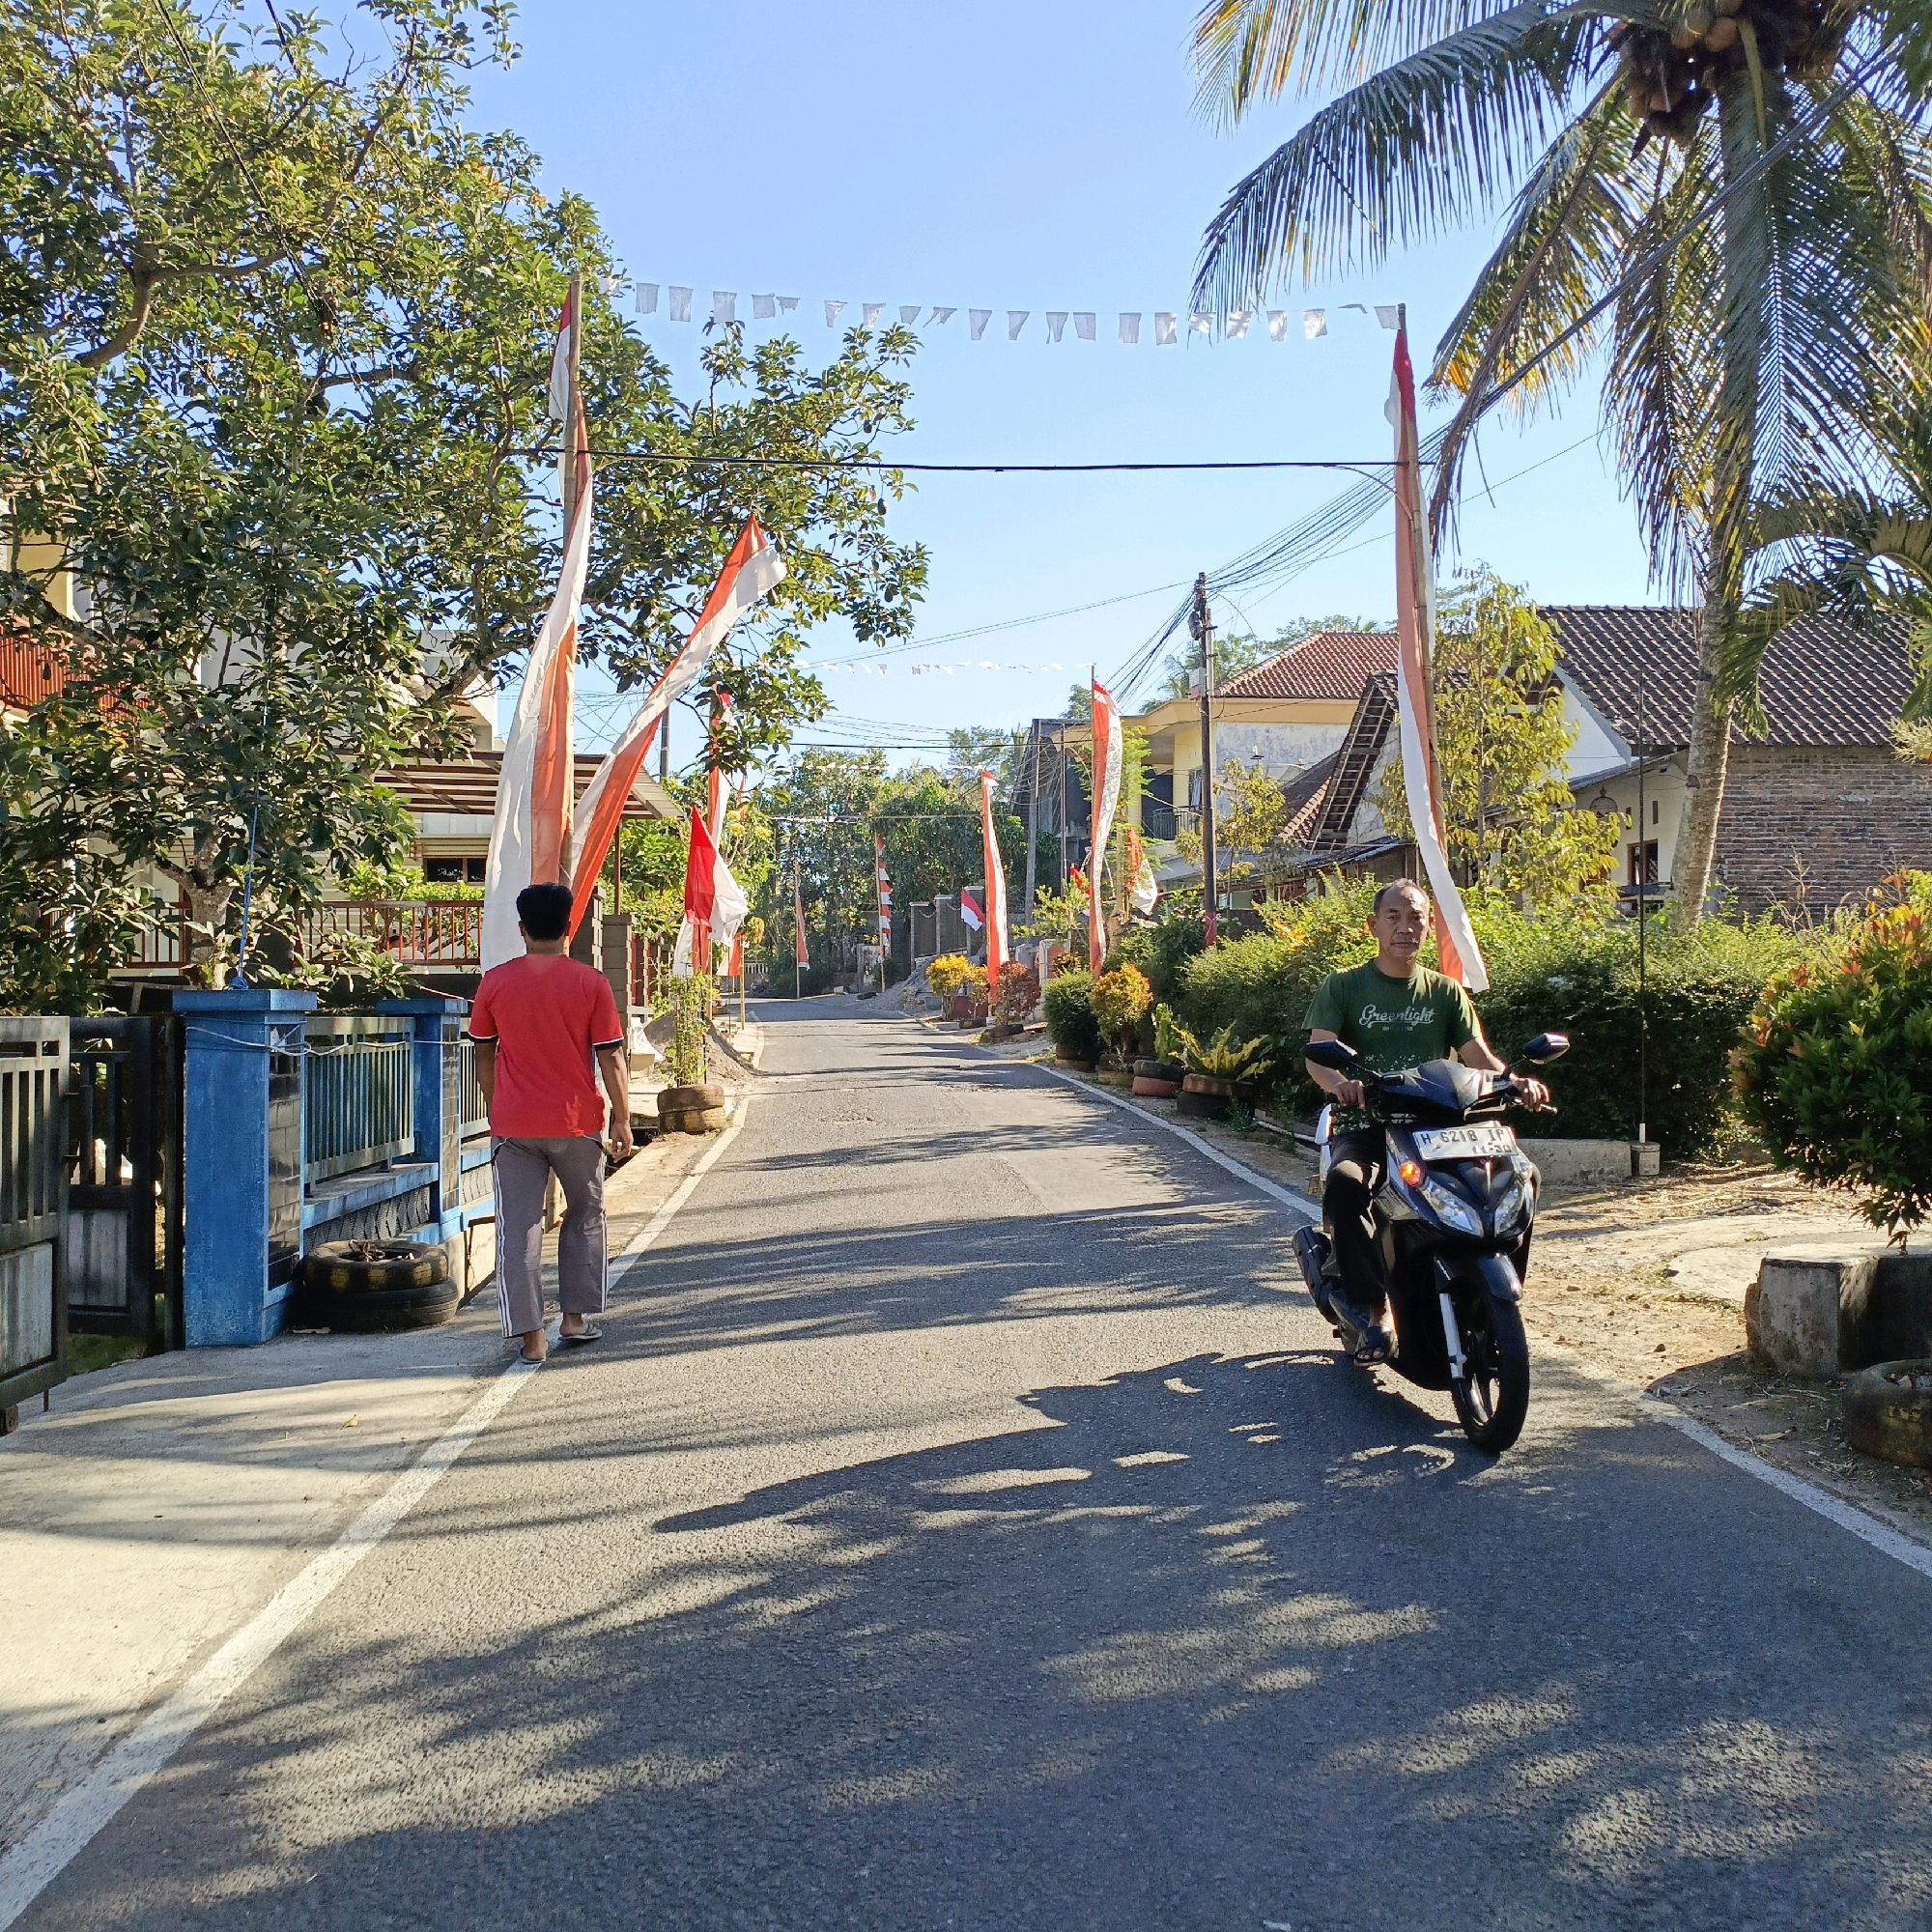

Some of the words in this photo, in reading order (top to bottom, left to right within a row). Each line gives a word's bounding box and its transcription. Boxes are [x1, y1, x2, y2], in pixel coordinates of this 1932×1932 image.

[1359, 1004, 1436, 1028] Greenlight
[1420, 1133, 1432, 1145] H
[1440, 1129, 1478, 1143] 6218
